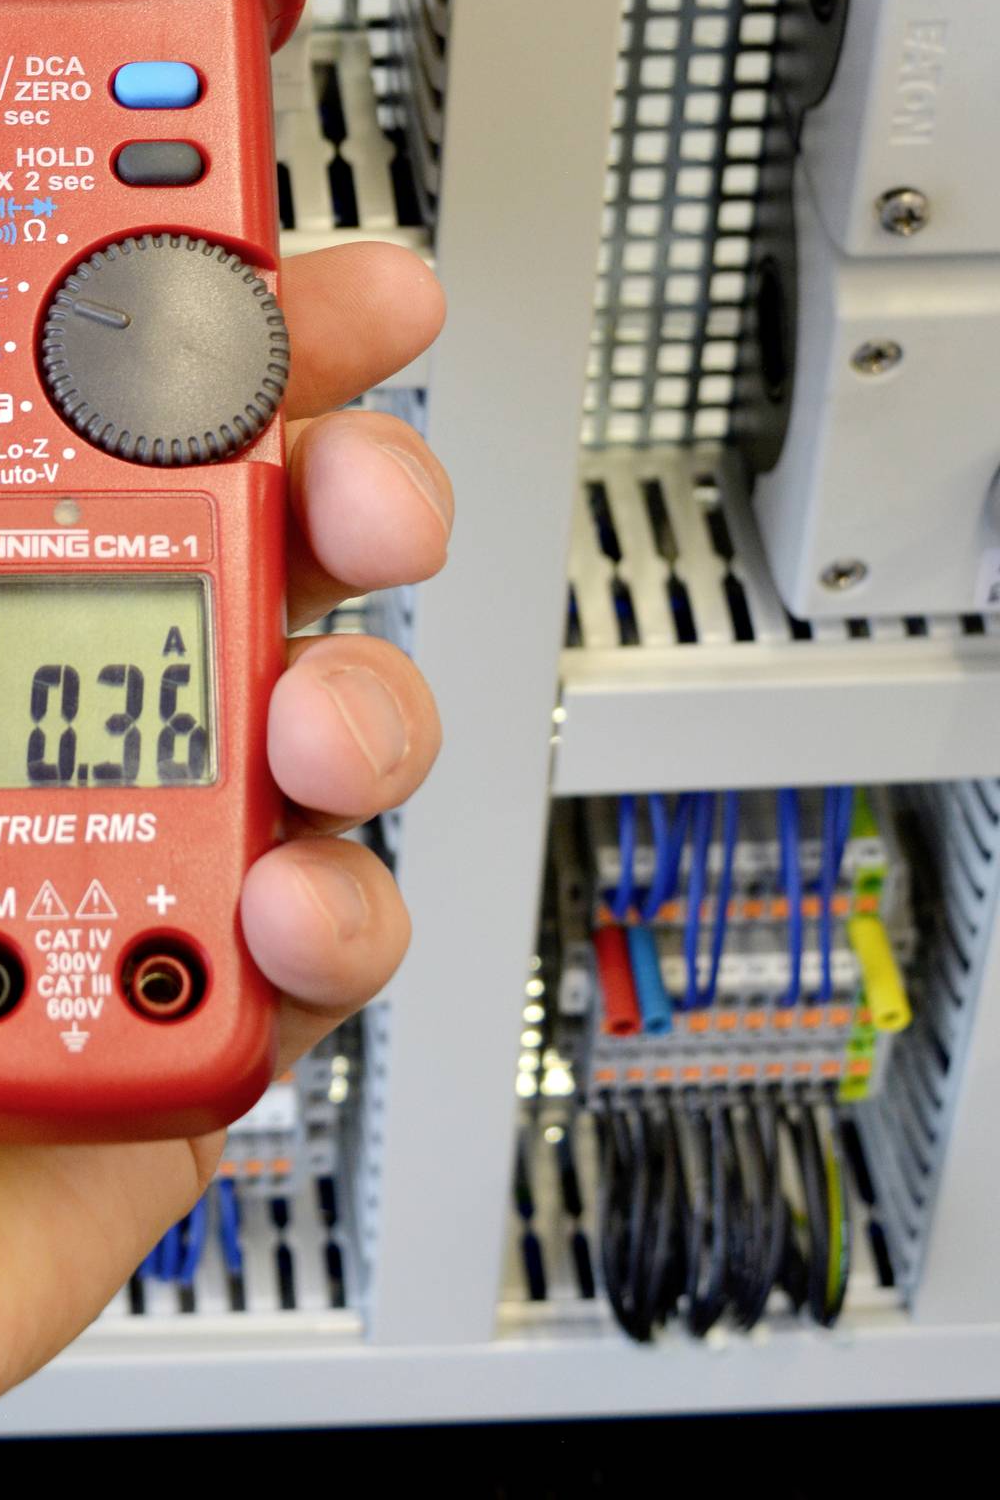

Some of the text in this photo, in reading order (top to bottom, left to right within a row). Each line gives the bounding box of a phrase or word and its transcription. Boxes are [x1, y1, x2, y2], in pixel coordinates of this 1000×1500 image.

[26, 56, 86, 76] DCA
[14, 81, 92, 101] ZERO
[4, 109, 50, 125] sec
[16, 147, 95, 168] HOLD
[24, 171, 41, 191] 2
[48, 174, 96, 191] sec
[162, 625, 187, 657] A
[26, 664, 208, 784] 0.36
[85, 813, 158, 843] RMS
[35, 928, 112, 951] CAT IV
[46, 952, 101, 974] 300V
[37, 974, 112, 996] CAT III
[46, 997, 104, 1020] 600V
